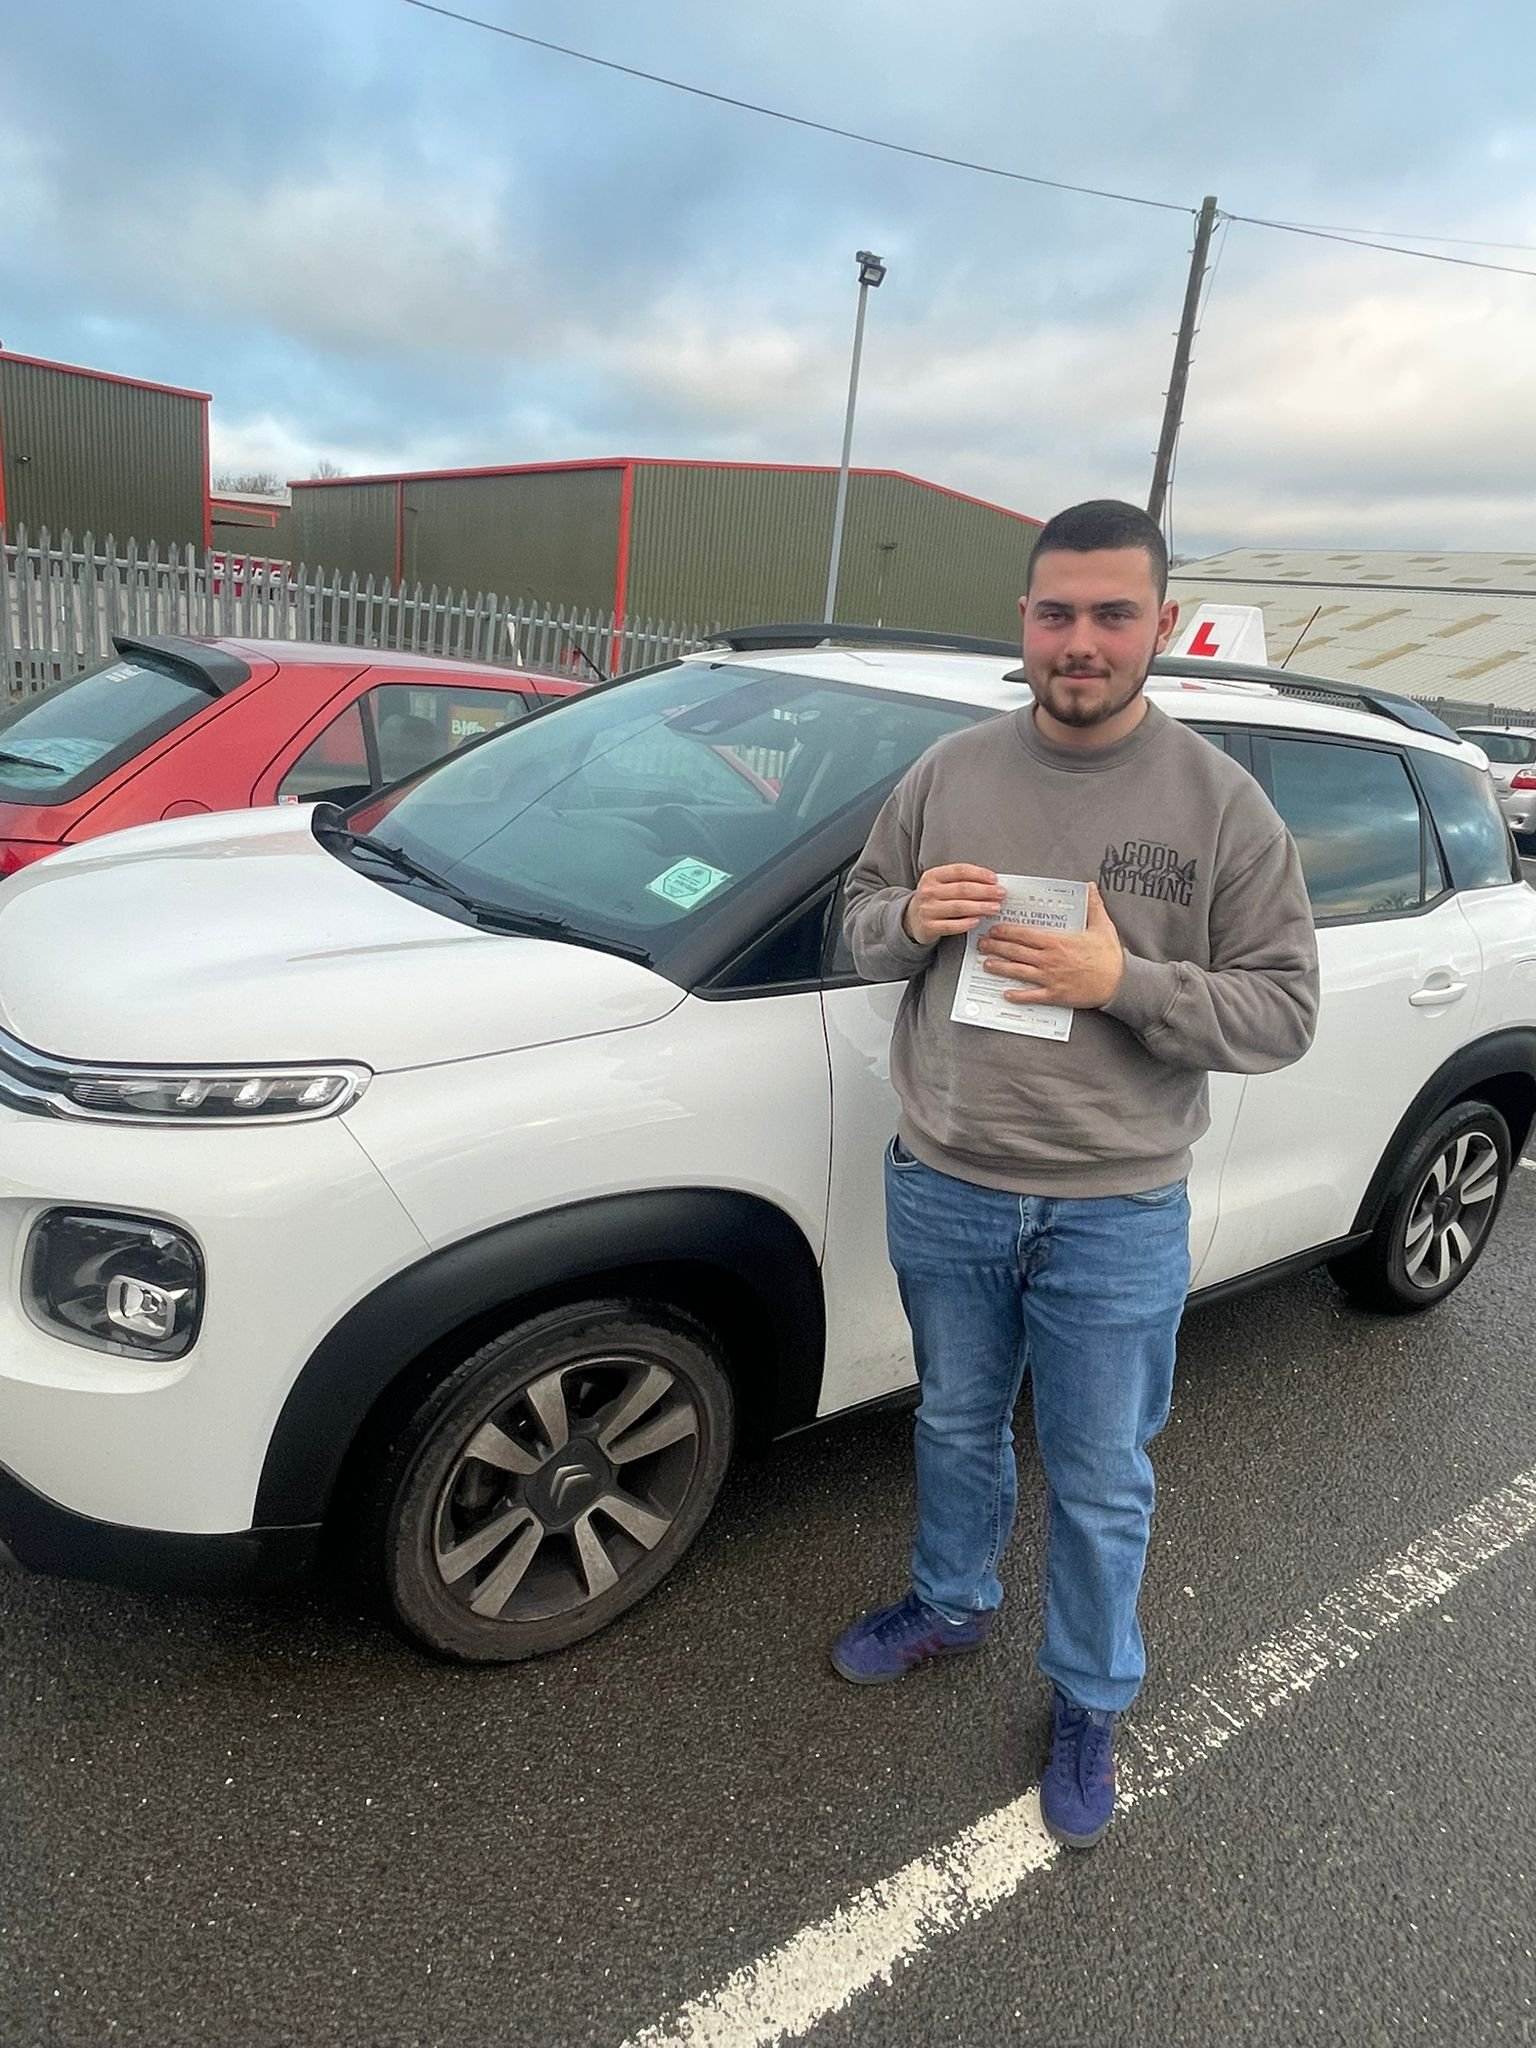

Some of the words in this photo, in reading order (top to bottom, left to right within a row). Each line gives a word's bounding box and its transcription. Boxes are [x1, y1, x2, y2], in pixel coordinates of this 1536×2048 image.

[1186, 622, 1220, 657] L
[1122, 841, 1178, 869] GOOD
[1098, 868, 1193, 907] NOTHING
[1021, 918, 1066, 929] CERTIFICATE
[1030, 911, 1068, 921] DRIVING
